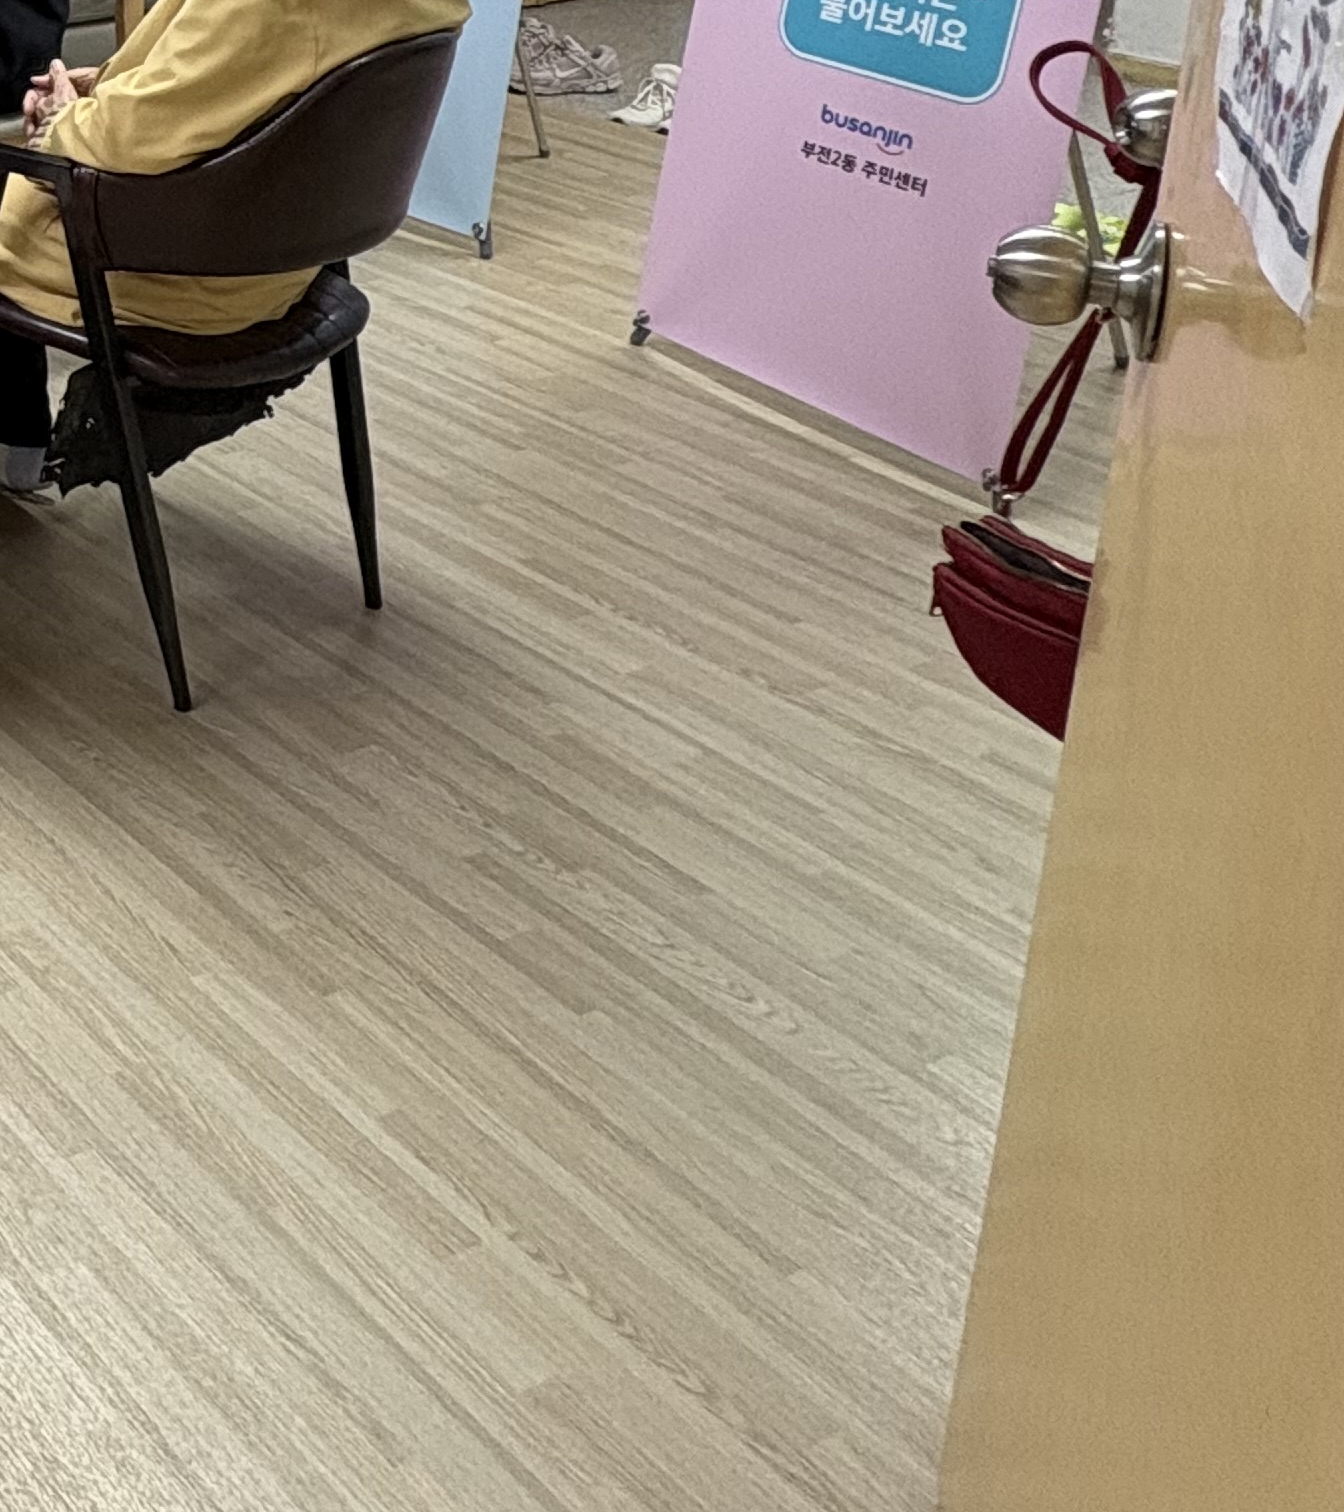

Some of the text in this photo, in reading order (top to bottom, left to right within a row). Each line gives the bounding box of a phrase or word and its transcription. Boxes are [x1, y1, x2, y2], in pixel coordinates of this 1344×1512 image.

[821, 104, 913, 150] busanjin
[801, 141, 928, 197] 부전2동 주민센터
